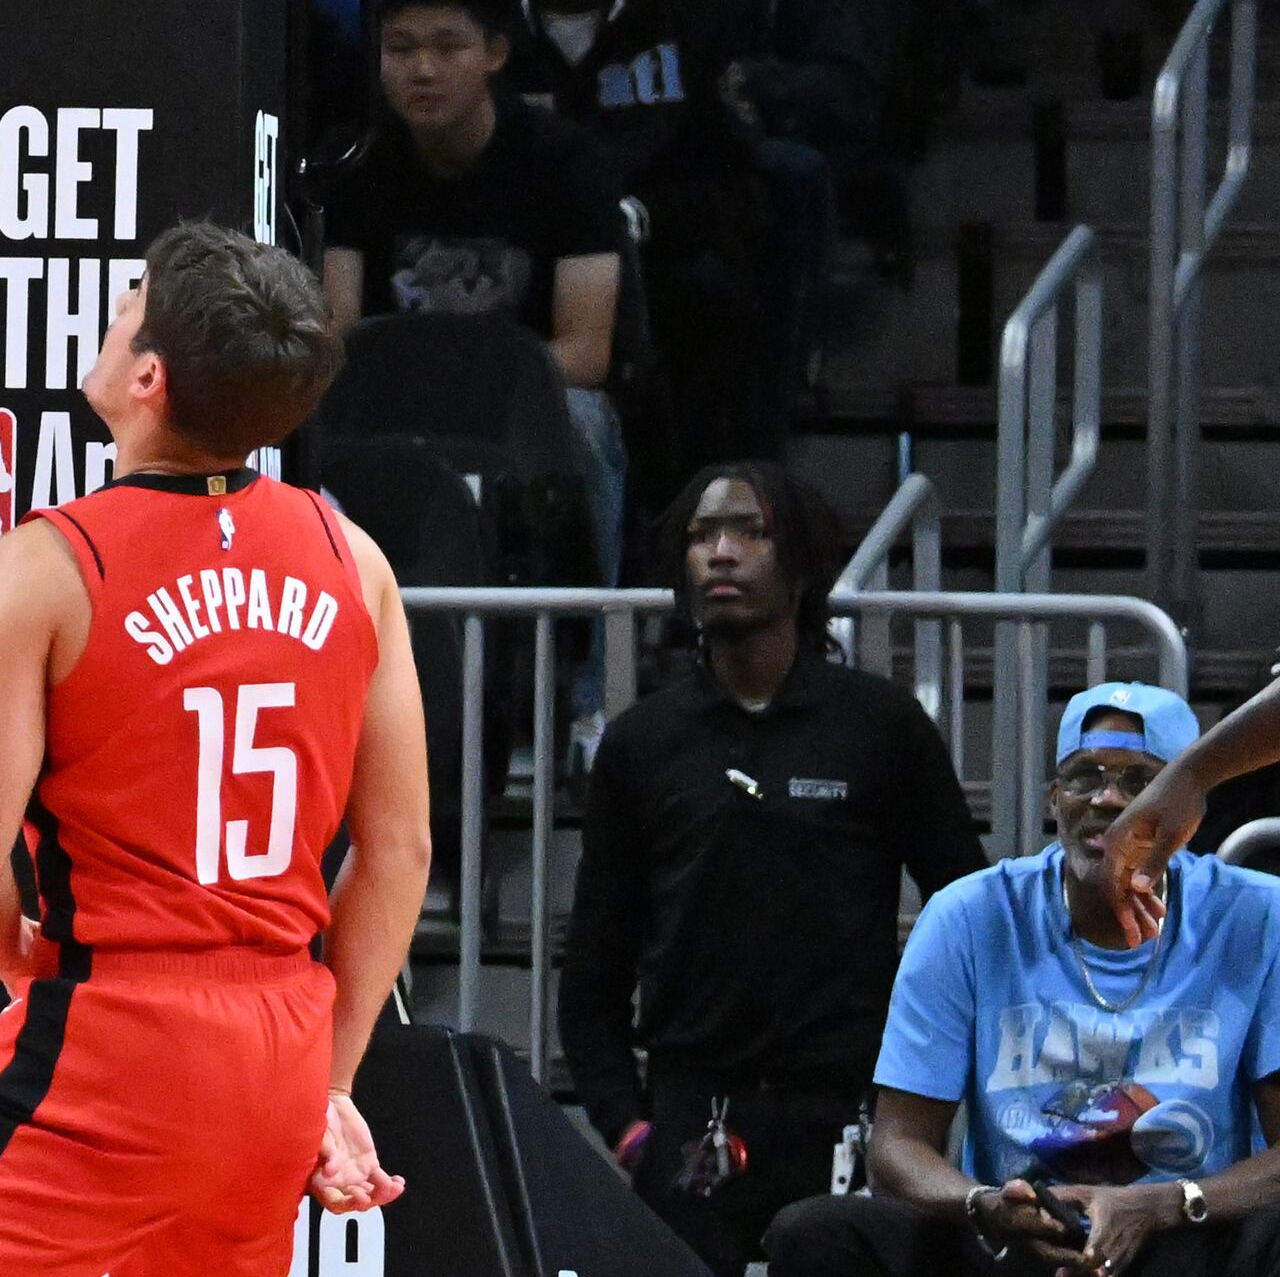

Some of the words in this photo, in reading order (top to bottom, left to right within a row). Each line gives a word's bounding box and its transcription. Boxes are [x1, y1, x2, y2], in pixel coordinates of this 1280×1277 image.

[254, 109, 279, 247] GET
[124, 567, 339, 665] SHEPPARD
[183, 682, 298, 885] 15
[986, 1003, 1220, 1092] HAWKS
